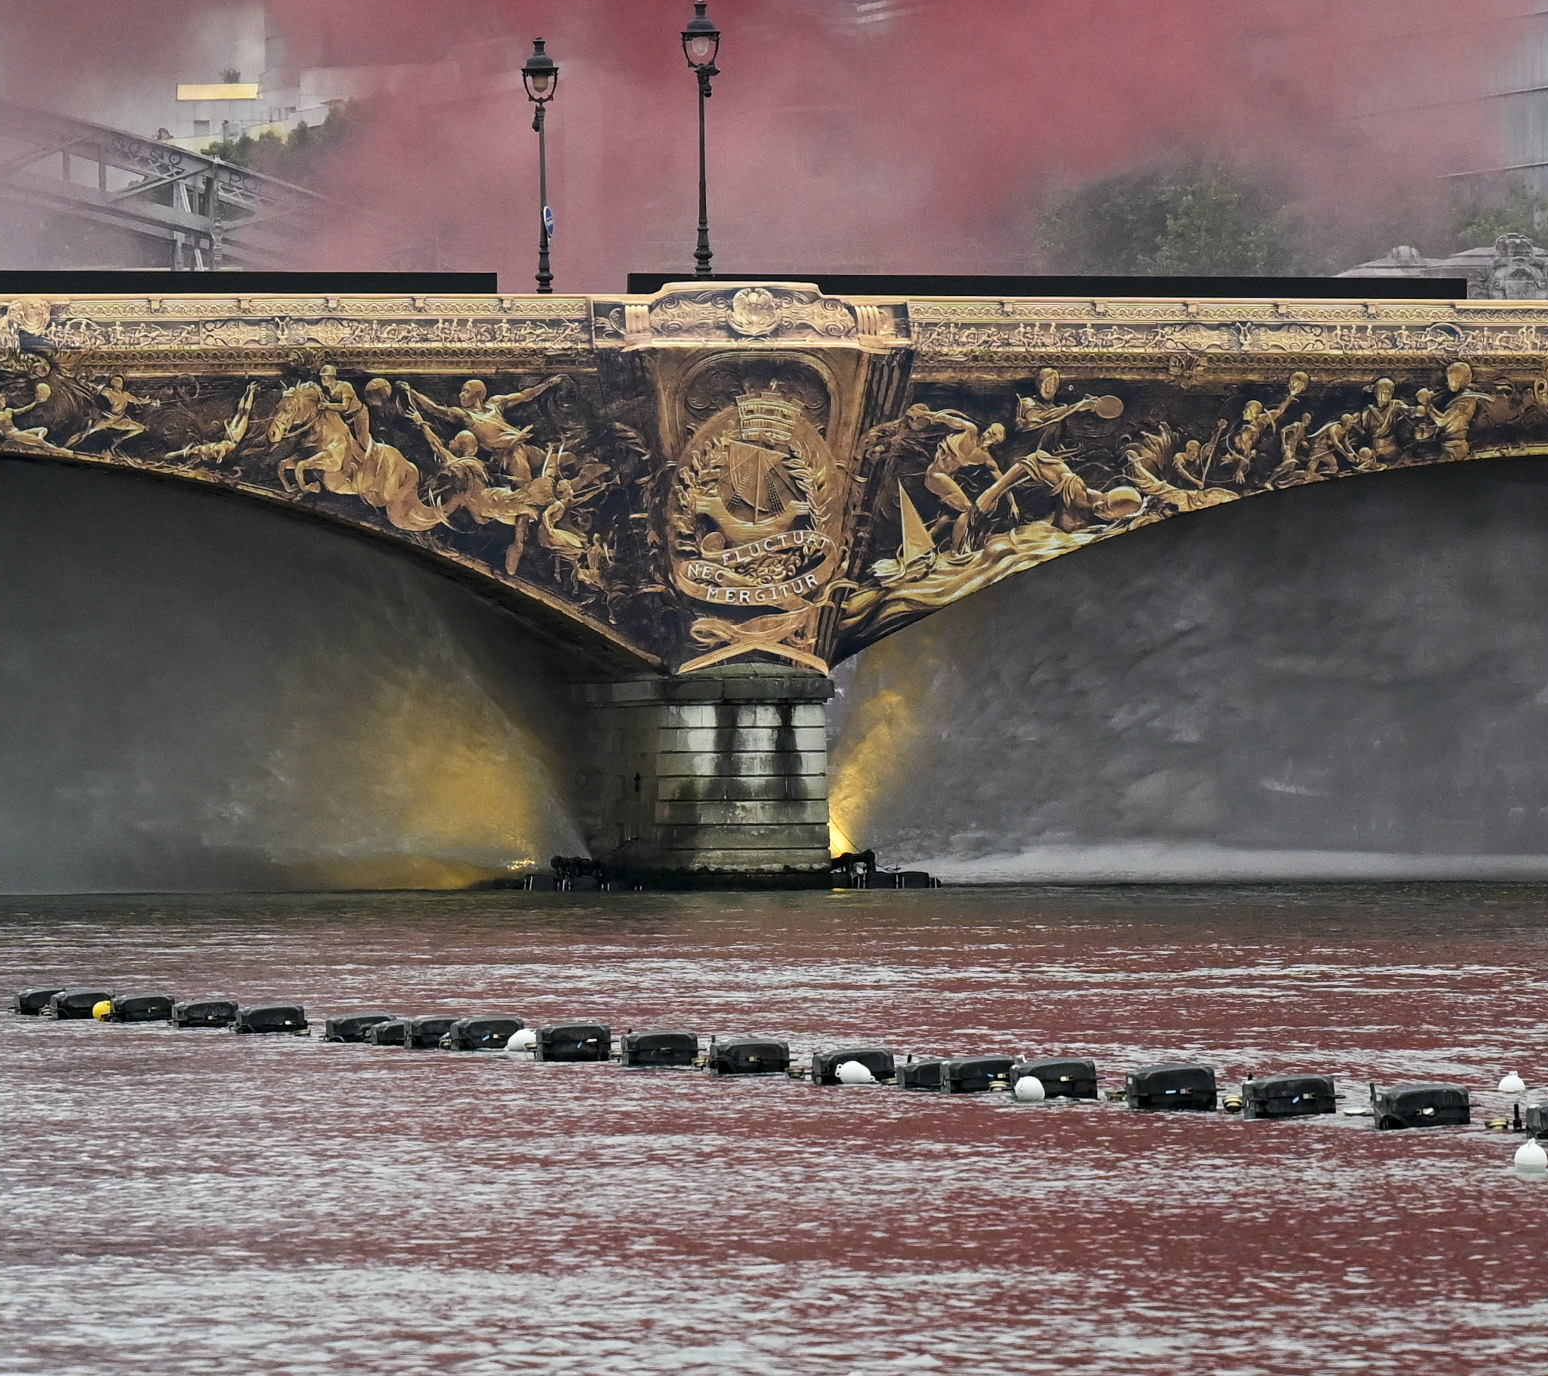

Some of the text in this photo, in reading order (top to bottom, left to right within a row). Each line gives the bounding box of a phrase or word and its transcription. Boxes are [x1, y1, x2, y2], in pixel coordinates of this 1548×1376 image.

[720, 531, 831, 566] FLUCTUAT
[687, 564, 725, 583] NEC
[706, 574, 819, 603] MERGITUR
